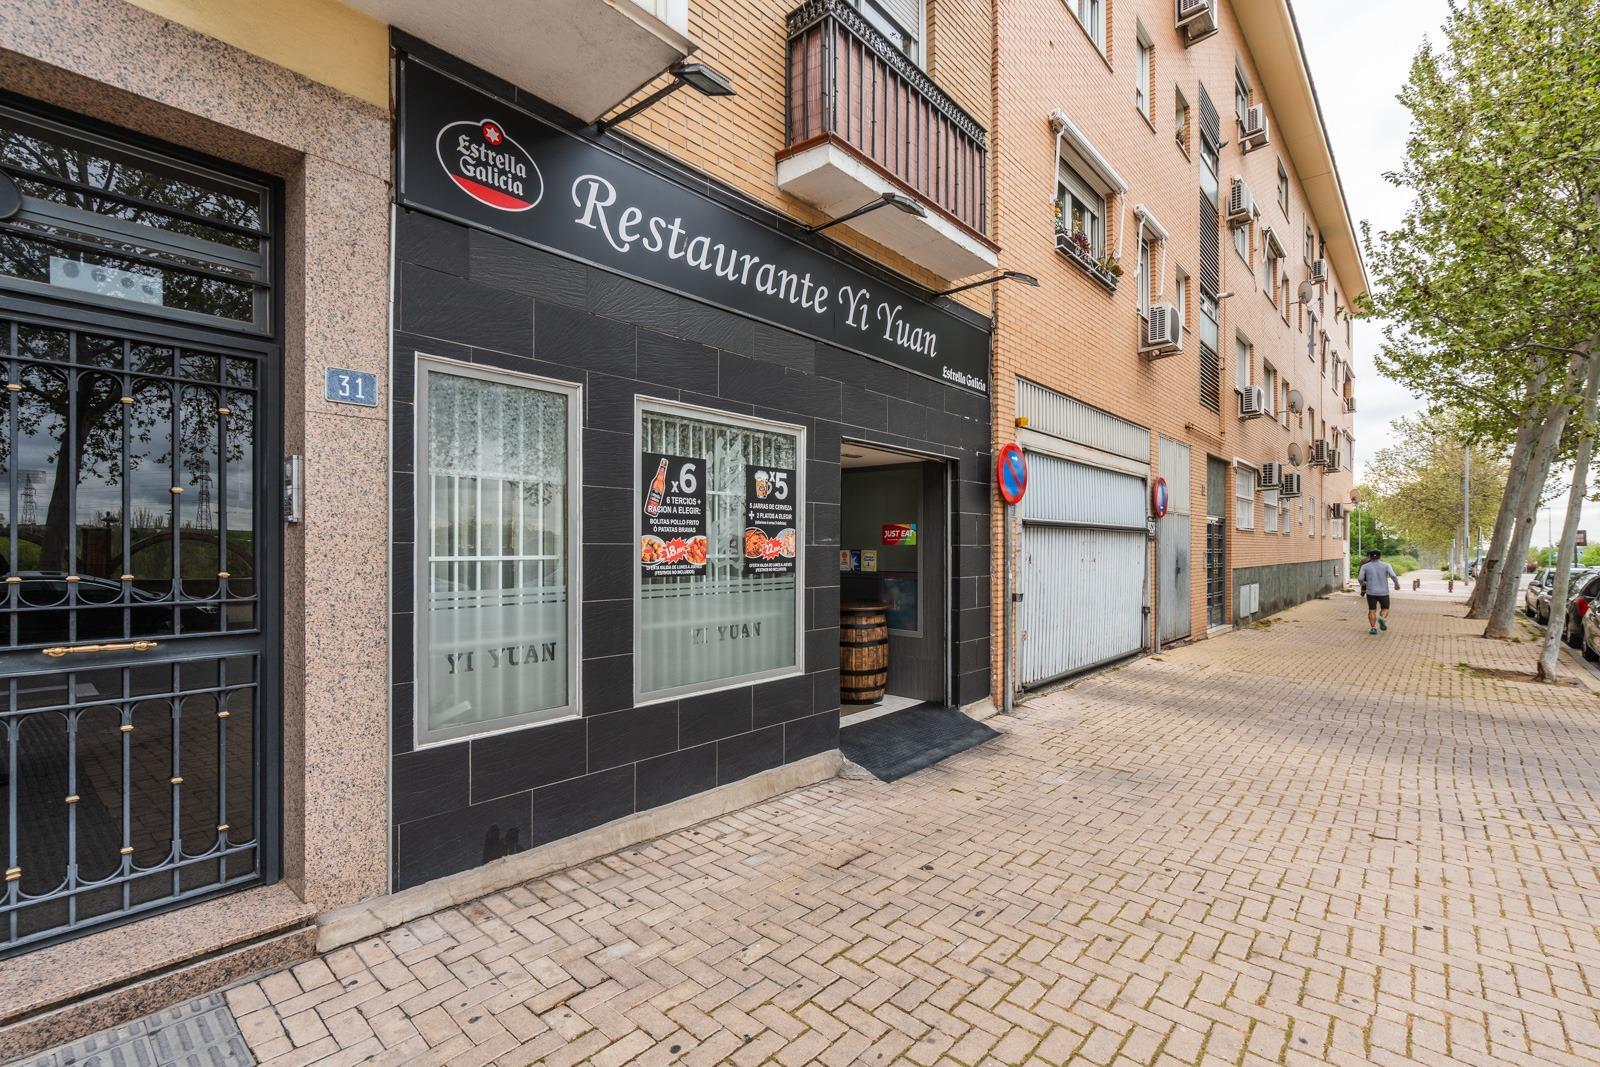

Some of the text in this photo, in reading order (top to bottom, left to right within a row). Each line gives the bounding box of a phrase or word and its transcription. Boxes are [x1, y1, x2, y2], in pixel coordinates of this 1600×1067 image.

[456, 134, 527, 179] Estrella
[459, 155, 524, 196] Galicia
[571, 174, 937, 358] Restaurante Yi Yuan
[338, 374, 365, 399] 31
[942, 365, 986, 392] Estrella Galicia
[671, 496, 697, 506] TERCIOS
[670, 518, 686, 526] POLLO
[884, 529, 914, 539] JUST EAT
[717, 621, 762, 641] YUAN
[447, 642, 557, 675] YI YUAN
